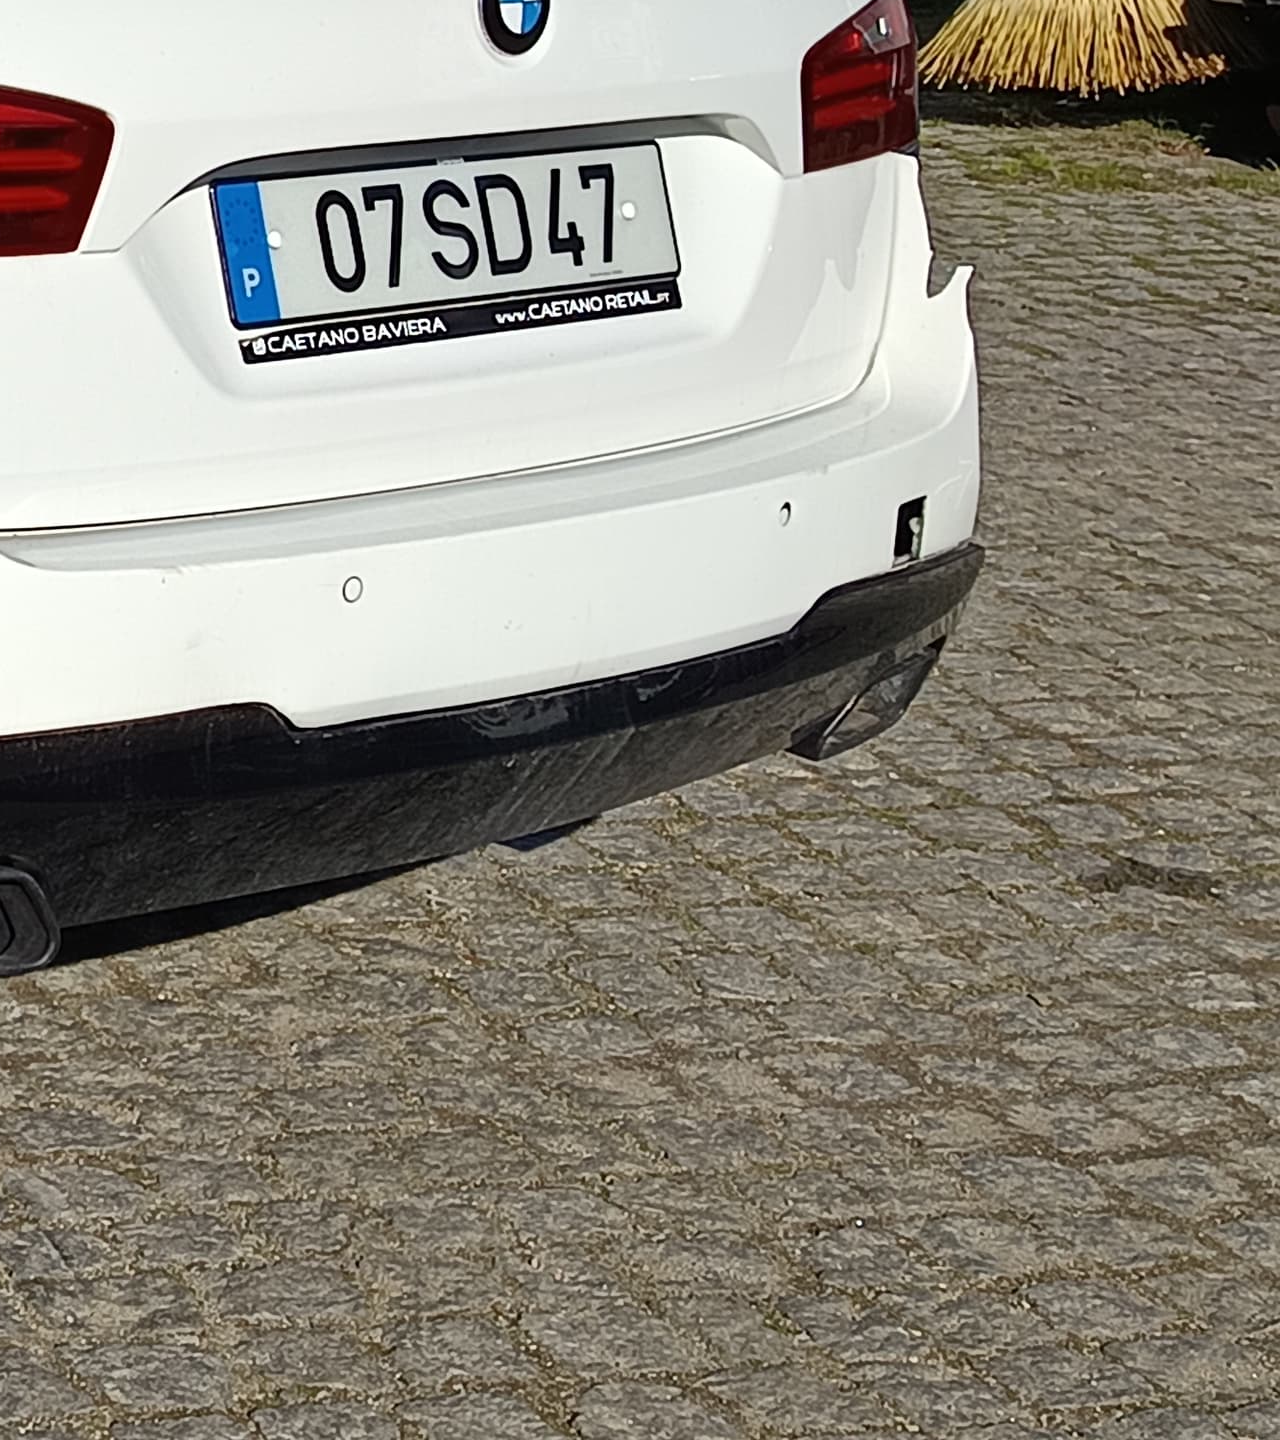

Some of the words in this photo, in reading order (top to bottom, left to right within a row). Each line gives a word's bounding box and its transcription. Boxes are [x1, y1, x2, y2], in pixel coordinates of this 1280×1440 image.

[242, 267, 260, 298] P
[267, 326, 359, 354] CAETANO
[361, 316, 448, 343] BAVIERA
